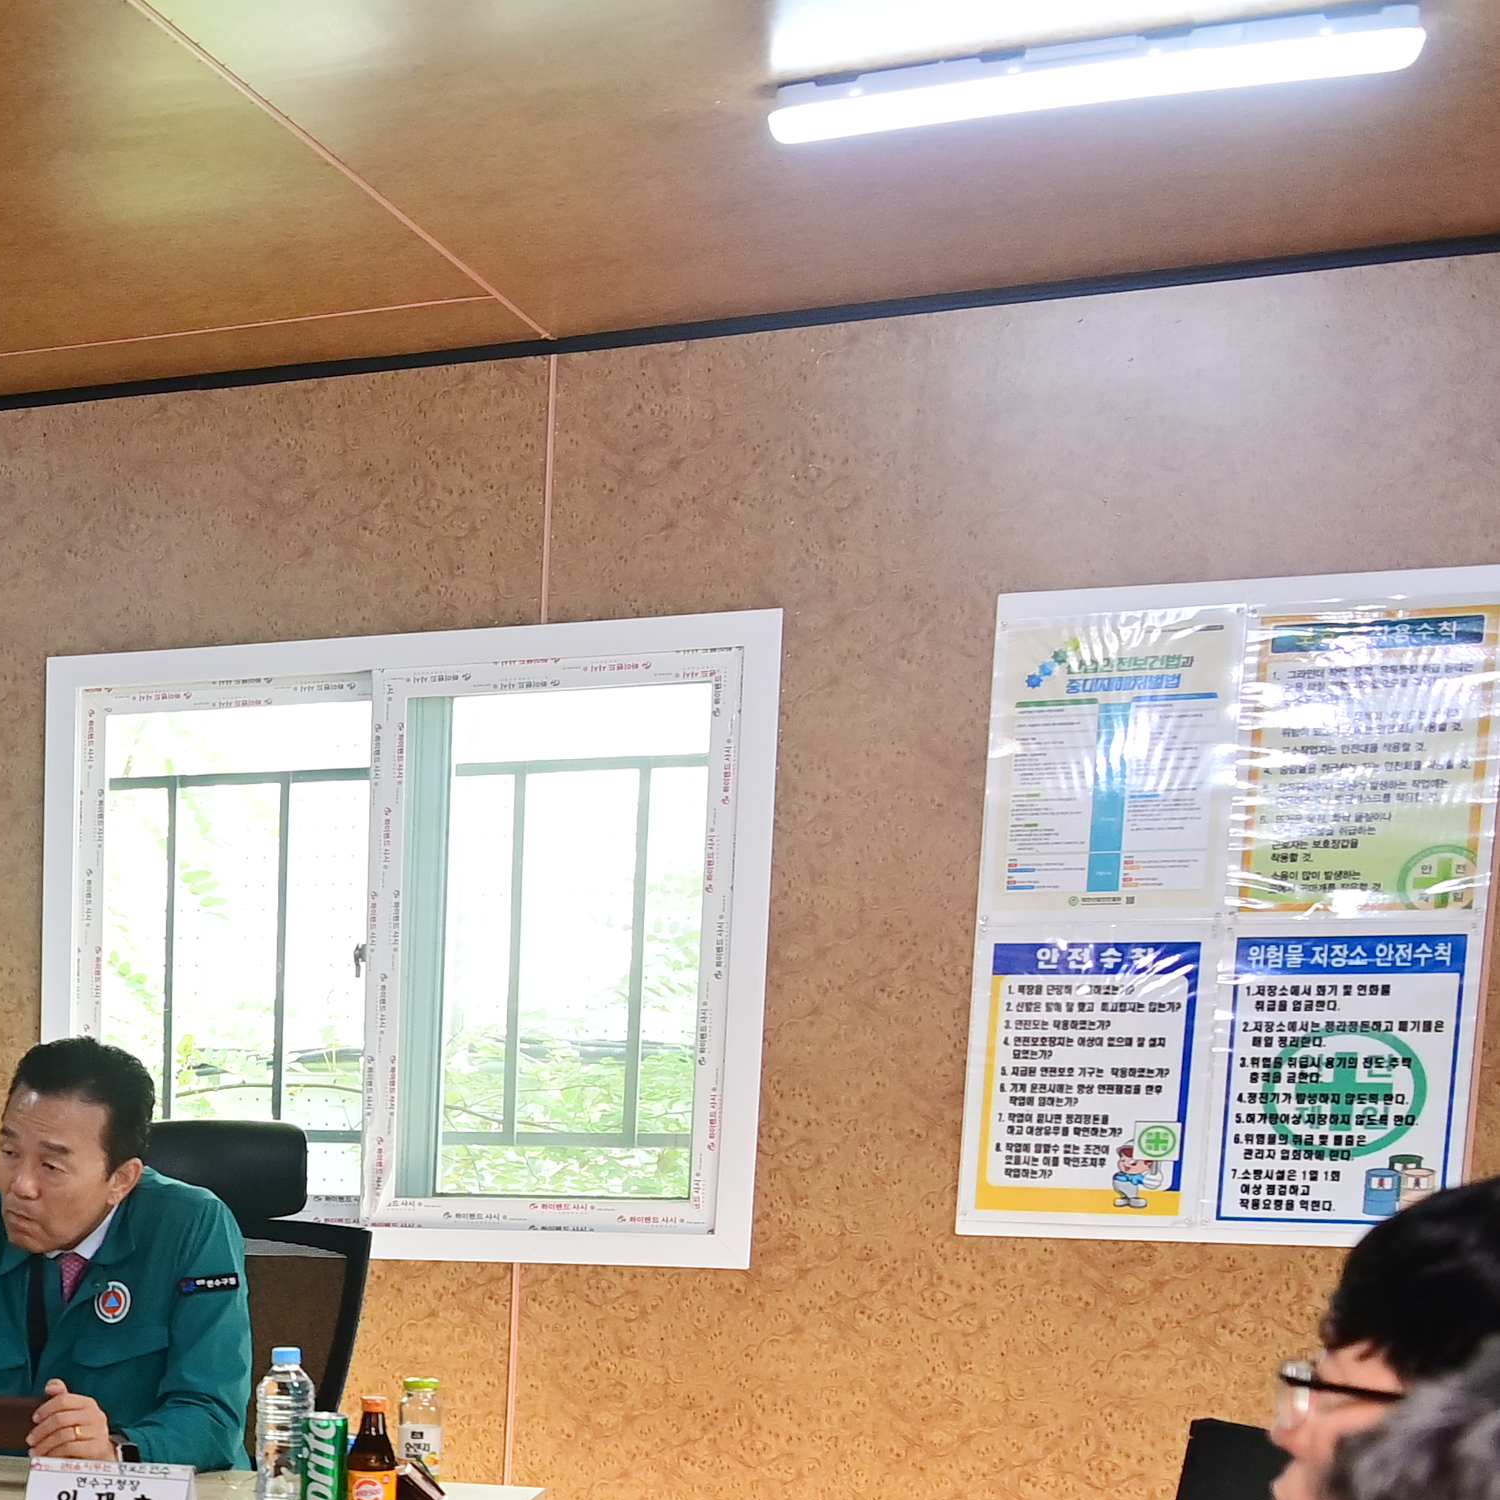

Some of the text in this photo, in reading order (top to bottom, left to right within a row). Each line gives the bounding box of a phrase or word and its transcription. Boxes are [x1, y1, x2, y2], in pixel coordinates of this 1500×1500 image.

[1312, 839, 1358, 850] 보호장갑을
[1271, 852, 1298, 863] 착용할
[1271, 872, 1298, 880] 소음이
[1248, 943, 1452, 968] 위험물 저장소 안전수칙
[1316, 985, 1338, 996] 화기
[1006, 1002, 1012, 1011] 2.
[1255, 1001, 1340, 1012] 취급을 엄금한다.
[1005, 1020, 1011, 1029] 3.
[1015, 1020, 1048, 1030] 안전모는
[1325, 1022, 1392, 1032] 정리정돈하고
[1004, 1037, 1010, 1046] 4.
[1077, 1037, 1103, 1047] 이상이
[1278, 1037, 1326, 1048] 정리한다.
[1325, 1058, 1357, 1069] 용기의
[1078, 1067, 1104, 1077] 기구는
[1383, 1094, 1409, 1105] 한다.
[998, 1113, 1004, 1122] 7.
[1008, 1113, 1032, 1123] 작업이
[1306, 1114, 1350, 1124] 저장하지
[1394, 1115, 1418, 1126] 한다.
[1007, 1126, 1023, 1135] 하고
[1244, 1150, 1275, 1160] 관리자
[1329, 1151, 1353, 1161] 한다.
[1324, 1171, 1340, 1181] 1회
[1241, 1185, 1310, 1196] 이상 점검하고
[76, 1477, 140, 1491] 연수구청장
